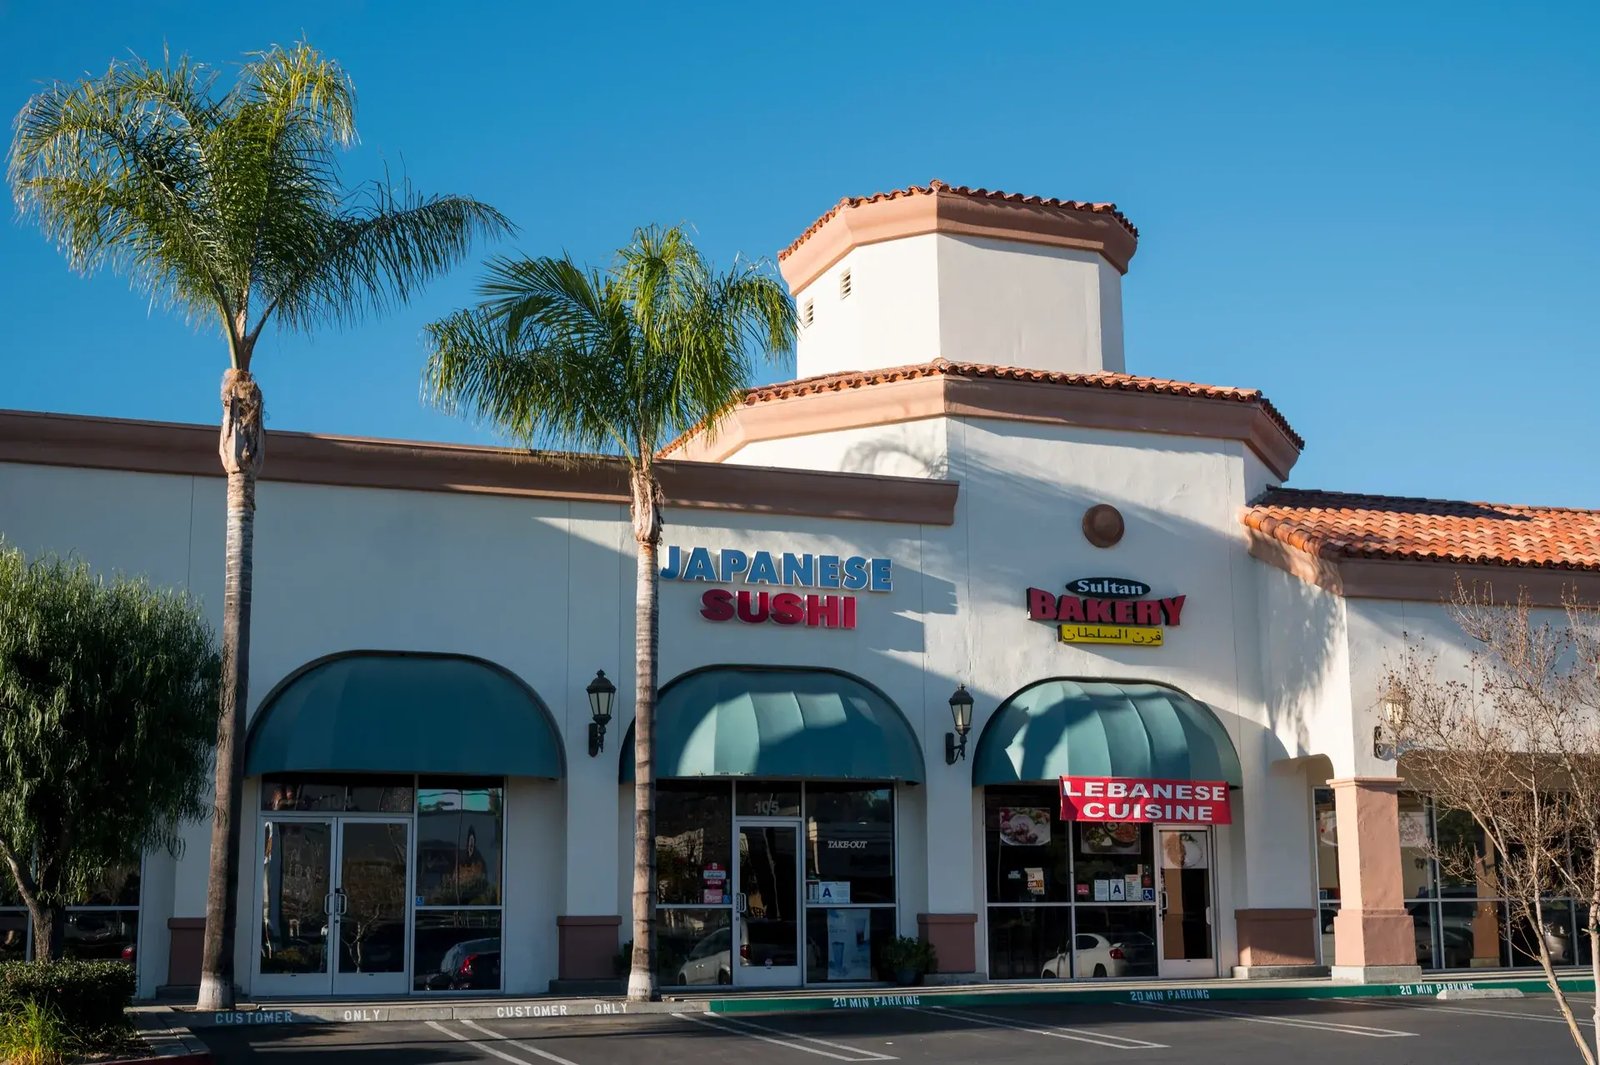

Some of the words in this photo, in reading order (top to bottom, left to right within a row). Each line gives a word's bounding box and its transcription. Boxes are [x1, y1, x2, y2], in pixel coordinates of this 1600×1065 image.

[660, 546, 894, 592] JAPANESE
[1077, 580, 1143, 595] Sultan
[700, 589, 858, 630] SUSHI
[1026, 587, 1187, 626] BAKERY
[1063, 627, 1128, 640] السلطان
[1132, 630, 1162, 644] فرن
[1063, 781, 1226, 801] LEBANESE
[755, 800, 780, 815] 105
[1082, 802, 1213, 821] CUISINE
[828, 840, 868, 849] TAKE-OUT
[822, 887, 832, 898] A
[1112, 884, 1122, 894] A
[1130, 991, 1144, 1000] 20
[1145, 991, 1164, 1000] MIN
[1167, 989, 1210, 1000] PARKING
[1399, 985, 1413, 995] 20
[1416, 984, 1433, 994] MIN
[832, 997, 847, 1008] 20
[849, 997, 869, 1008] MIN
[873, 995, 920, 1006] PARKING
[215, 1011, 293, 1024] CUSTOMER
[344, 1009, 380, 1021] ONLY
[497, 1005, 568, 1018] CUSTOMER
[594, 1002, 628, 1014] ONLY
